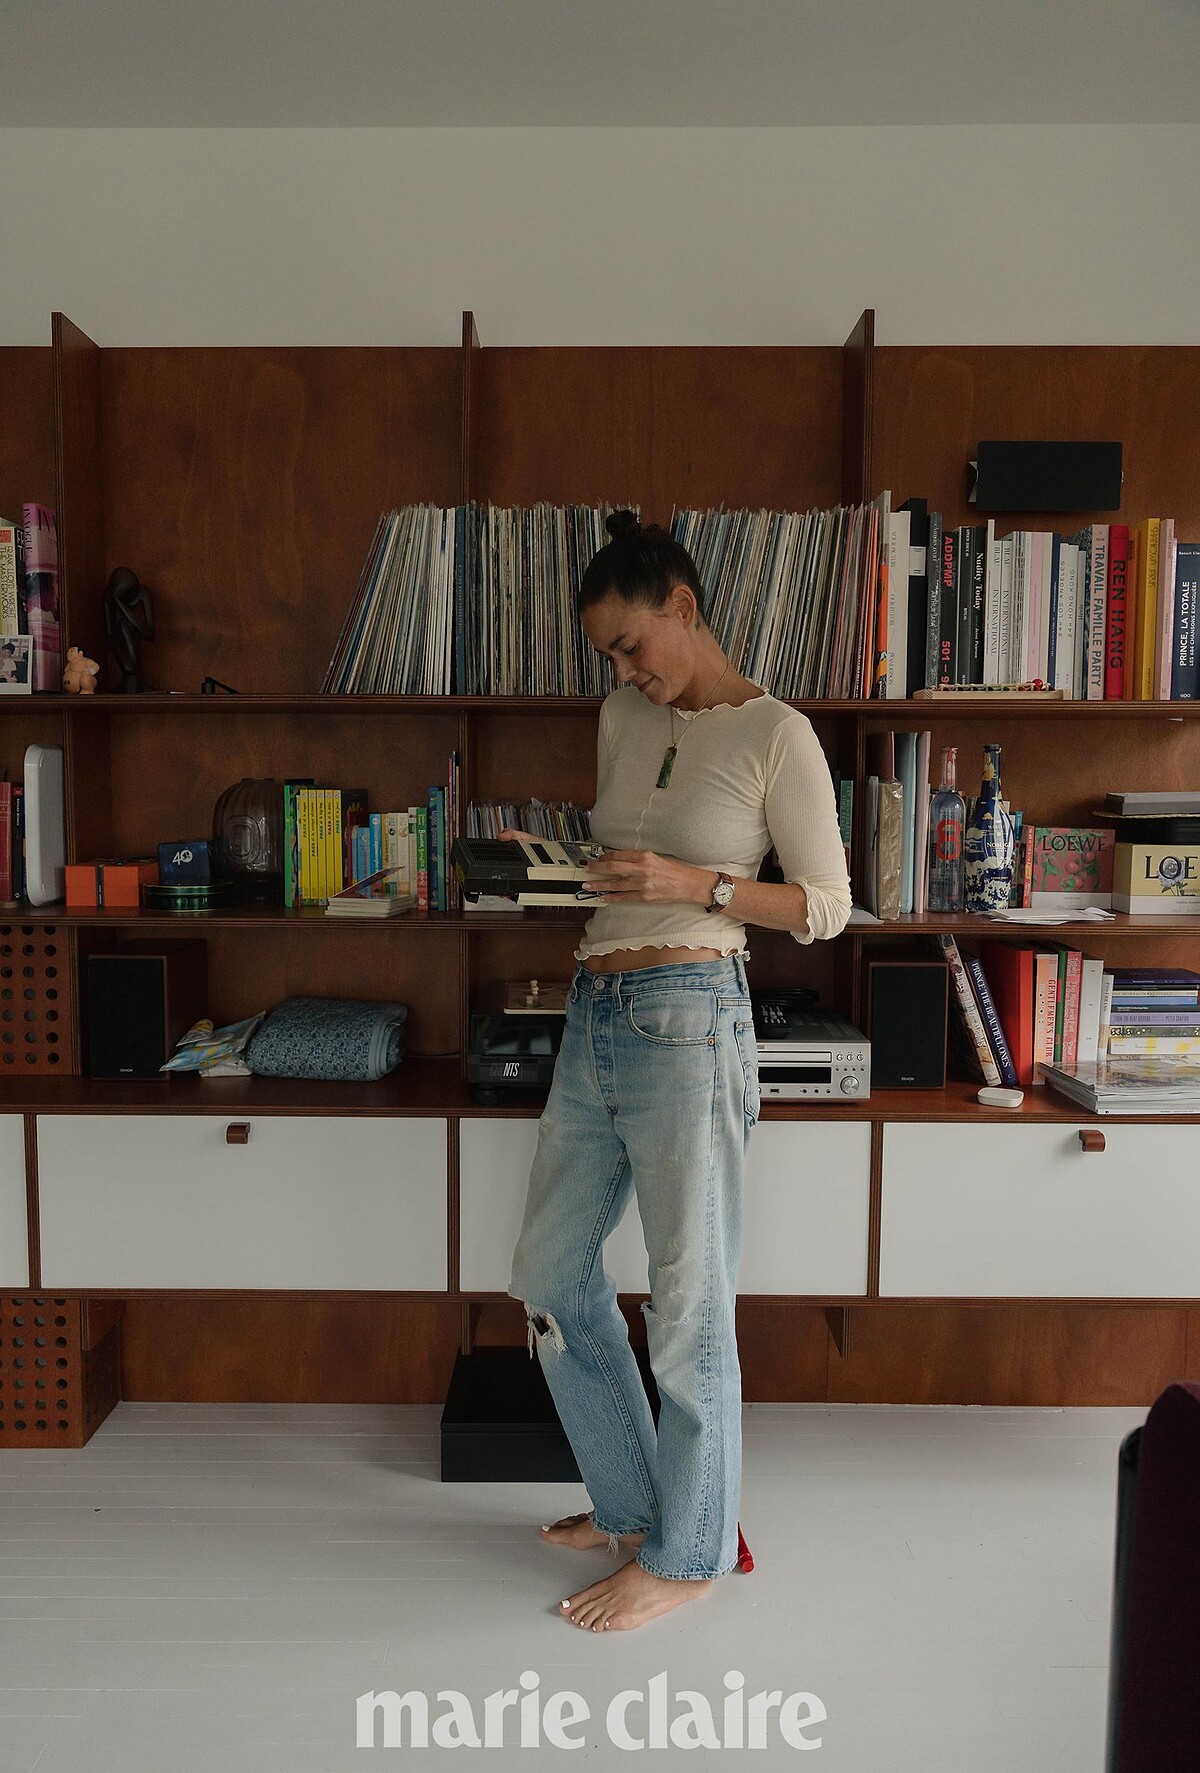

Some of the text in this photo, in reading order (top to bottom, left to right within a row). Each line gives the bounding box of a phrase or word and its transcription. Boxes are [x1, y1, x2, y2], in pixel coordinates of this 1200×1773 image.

[944, 536, 954, 587] ADDPMP
[973, 552, 984, 610] Nudity Today
[1094, 545, 1105, 593] TRAVAIL
[1, 563, 9, 619] MASTERWORKS
[1110, 560, 1126, 669] REN HANG
[1092, 598, 1104, 646] FAMILLE
[1180, 582, 1190, 666] PRINCE, LA TOTALE
[942, 640, 950, 661] 501
[1091, 651, 1102, 687] PARTY
[936, 819, 961, 862] 8
[1042, 836, 1107, 851] LOEWE
[972, 962, 1010, 1068] PRINCE THE BEAUTIFUL ONES
[1046, 980, 1056, 1057] GENTLEMEN'S CLUB
[502, 1062, 520, 1077] NTS
